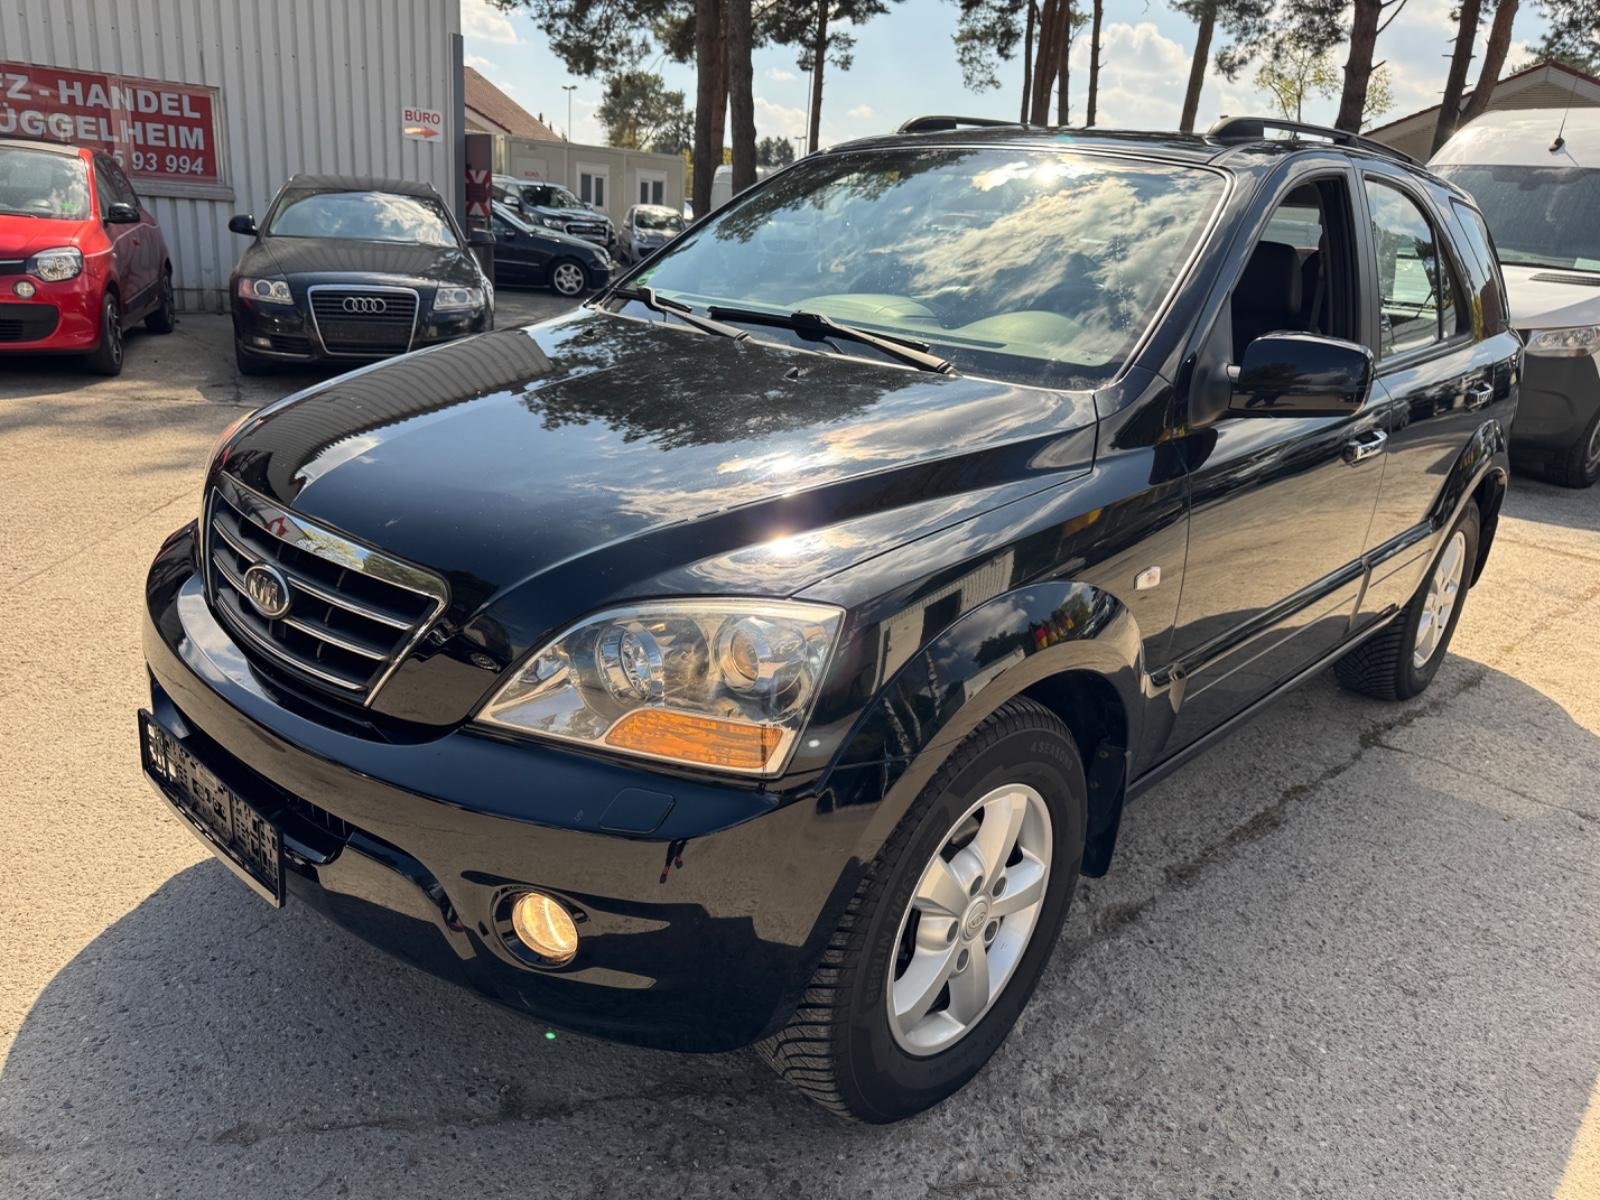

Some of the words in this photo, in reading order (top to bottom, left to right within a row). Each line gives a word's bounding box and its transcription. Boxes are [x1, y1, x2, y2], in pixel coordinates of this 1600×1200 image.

[58, 80, 201, 118] HANDEL
[404, 108, 441, 125] BÜRO
[132, 151, 158, 171] 93
[165, 154, 204, 175] 994
